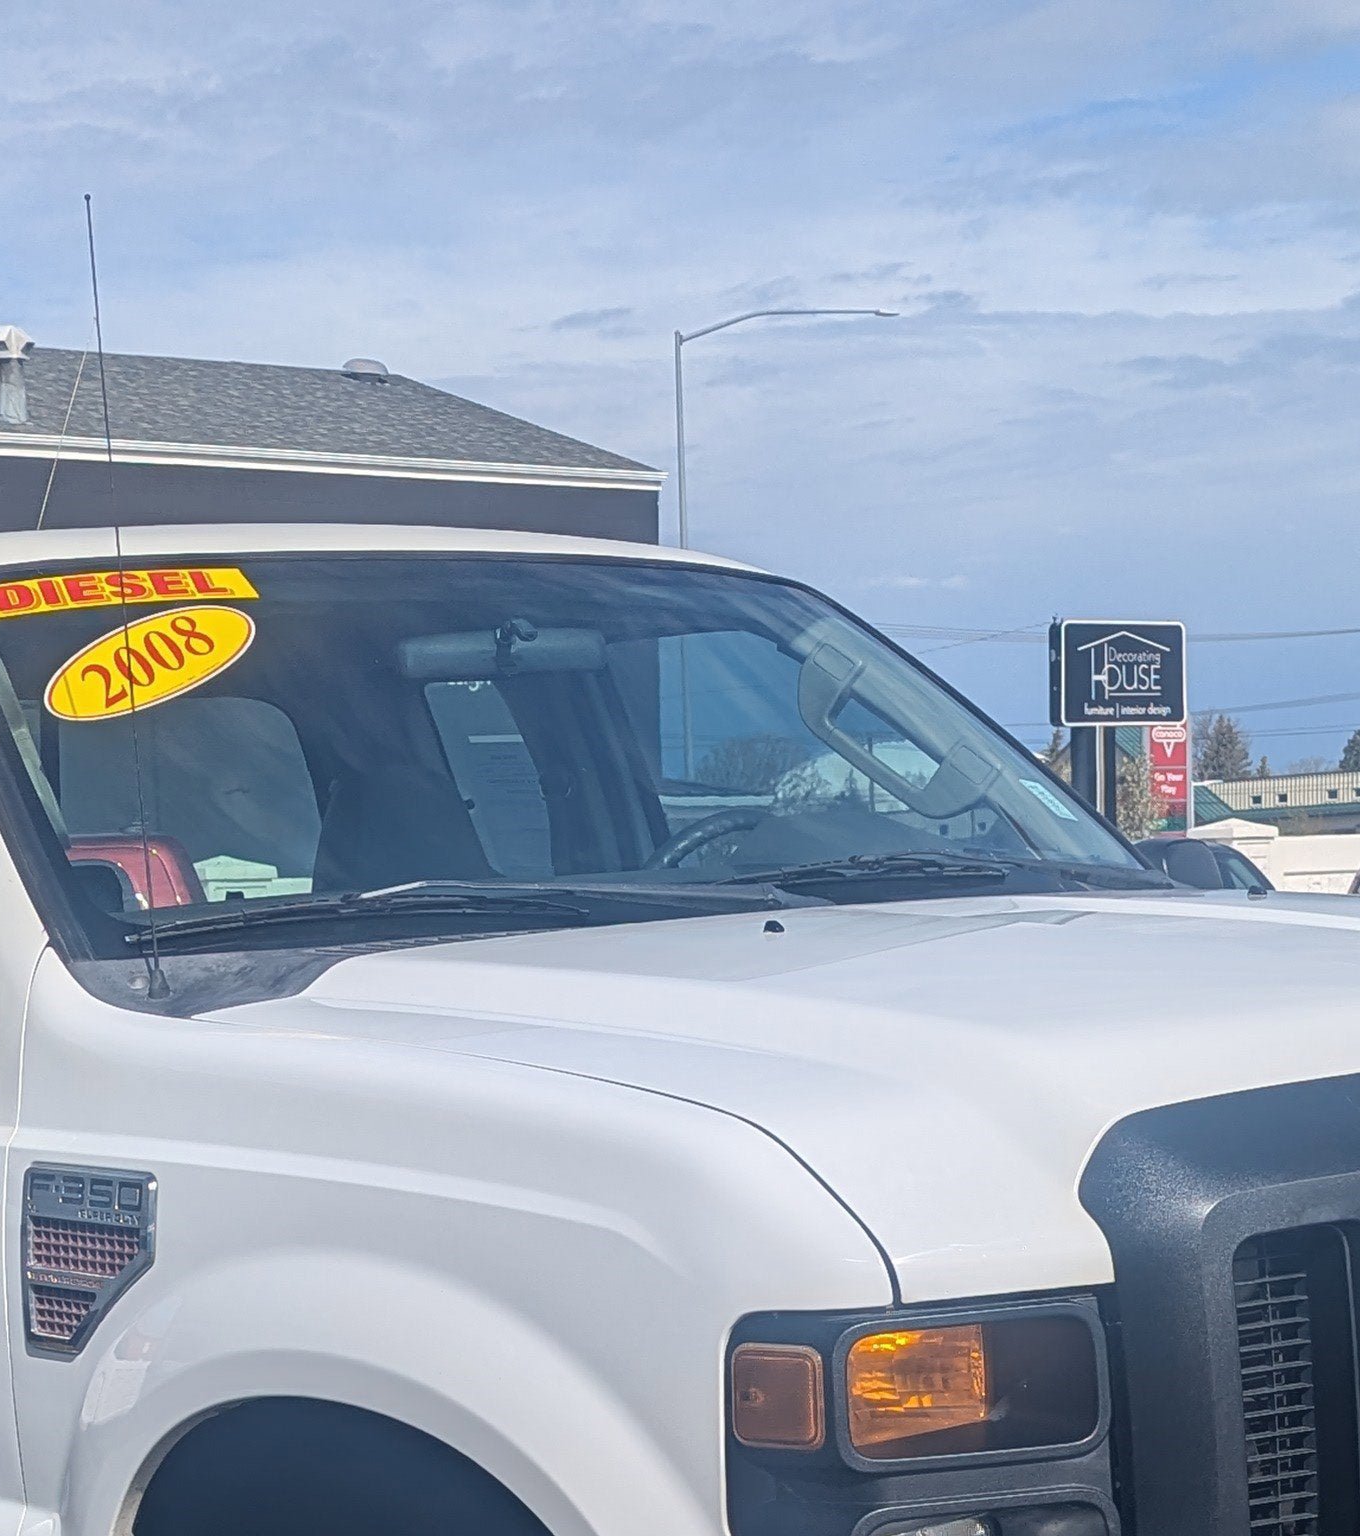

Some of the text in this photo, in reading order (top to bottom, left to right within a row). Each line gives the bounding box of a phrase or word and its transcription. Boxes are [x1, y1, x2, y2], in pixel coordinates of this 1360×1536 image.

[81, 615, 215, 708] 2008
[1091, 643, 1162, 700] HOUSE
[1108, 646, 1161, 664] Decorating
[1147, 702, 1172, 717] design
